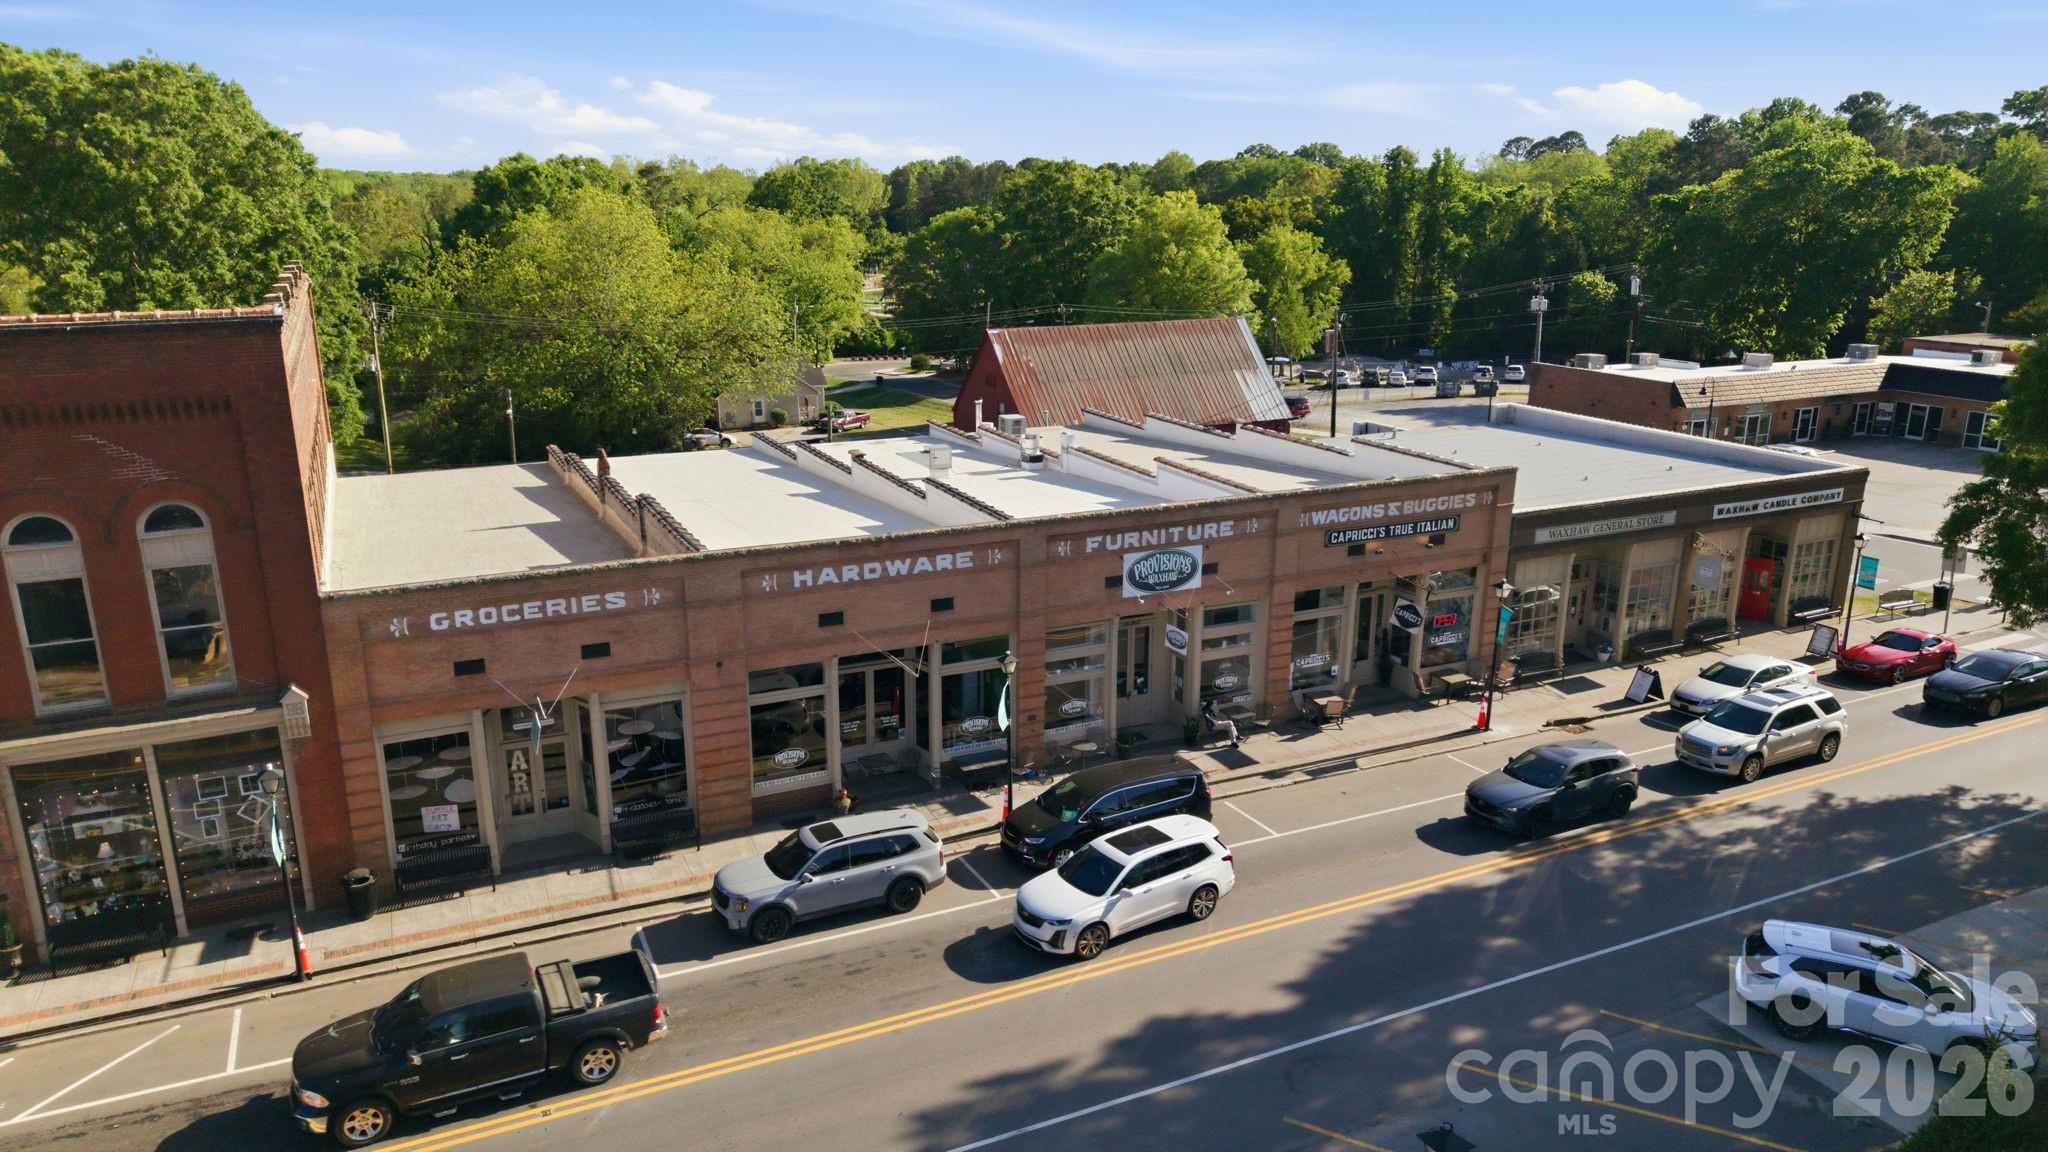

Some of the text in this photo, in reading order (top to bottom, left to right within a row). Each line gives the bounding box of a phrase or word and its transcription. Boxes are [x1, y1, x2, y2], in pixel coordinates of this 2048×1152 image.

[1311, 493, 1477, 526] WAGONS & BUGGIES
[1716, 491, 1842, 516] WAXHAW CANDLE COMPANY
[1085, 519, 1235, 553] FURNITURE
[1331, 517, 1455, 543] CAPRICCI'S TRUE ITALIAN
[1549, 514, 1665, 540] WAXHAW GENERAL STORE
[793, 551, 974, 588] HARDWARE
[1134, 552, 1193, 581] PROVISIONS
[1148, 570, 1179, 584] WAXHAW
[429, 591, 626, 631] GROCERIES
[1435, 614, 1456, 626] OPEN
[511, 749, 531, 813] ART
